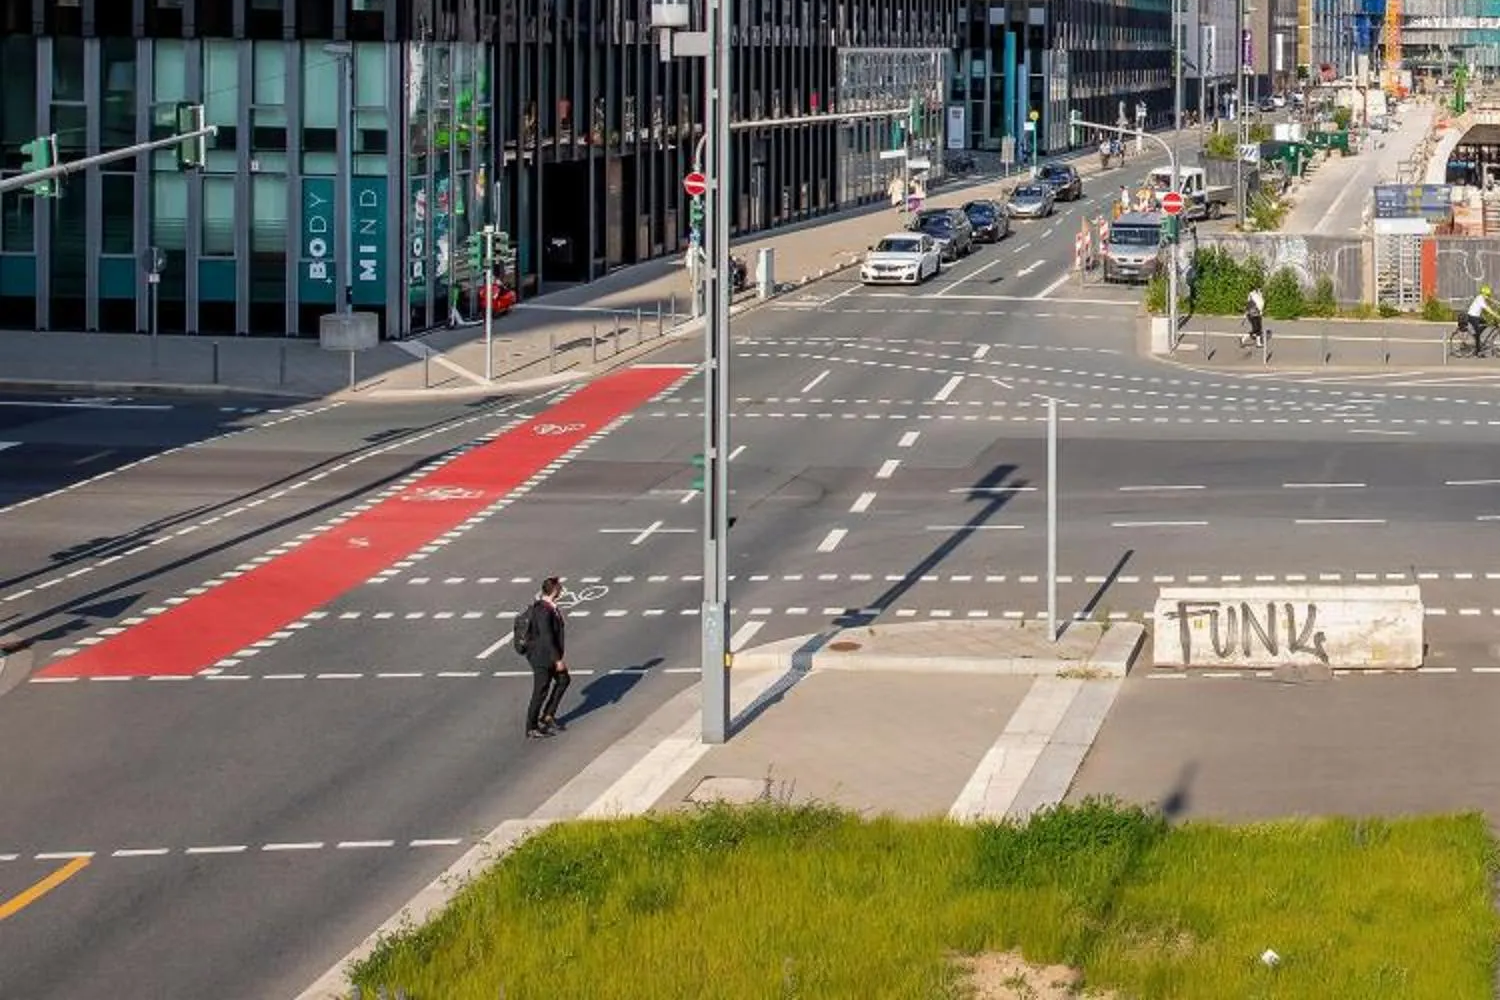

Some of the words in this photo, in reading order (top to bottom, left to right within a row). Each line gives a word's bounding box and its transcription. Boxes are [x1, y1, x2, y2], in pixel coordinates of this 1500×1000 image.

[309, 192, 327, 280] BODY
[359, 189, 377, 281] MIND
[1164, 602, 1329, 664] FUNK
